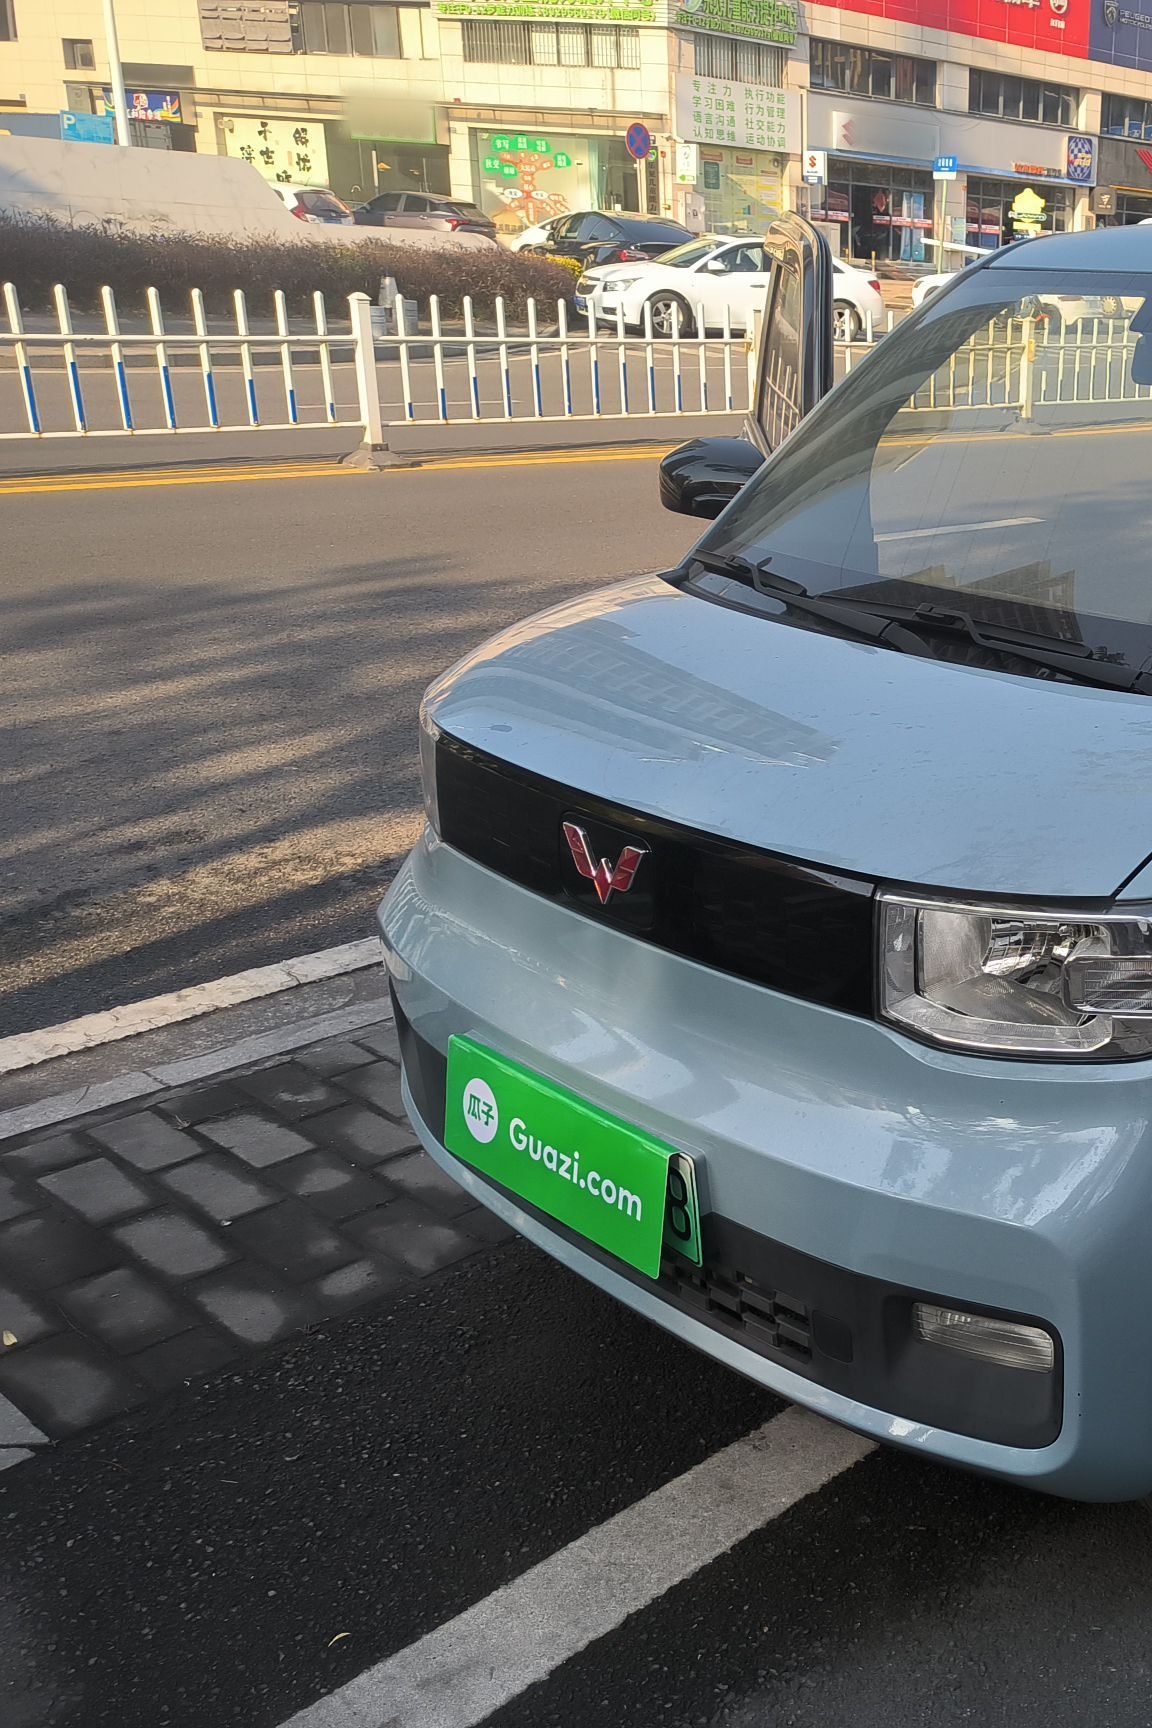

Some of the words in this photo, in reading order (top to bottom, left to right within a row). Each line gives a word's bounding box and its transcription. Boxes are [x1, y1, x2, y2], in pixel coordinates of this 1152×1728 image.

[693, 80, 732, 97] 专注力
[745, 87, 786, 105] 执行功能
[692, 95, 736, 112] 学习困难
[745, 102, 786, 119] 行为管理
[63, 113, 76, 129] P
[693, 110, 736, 128] 语言沟通
[745, 117, 786, 134] 社交能力
[693, 126, 737, 142] 认知思维
[745, 132, 786, 149] 运动协调
[467, 1093, 495, 1126] 瓜子
[508, 1117, 643, 1223] Guazi.com
